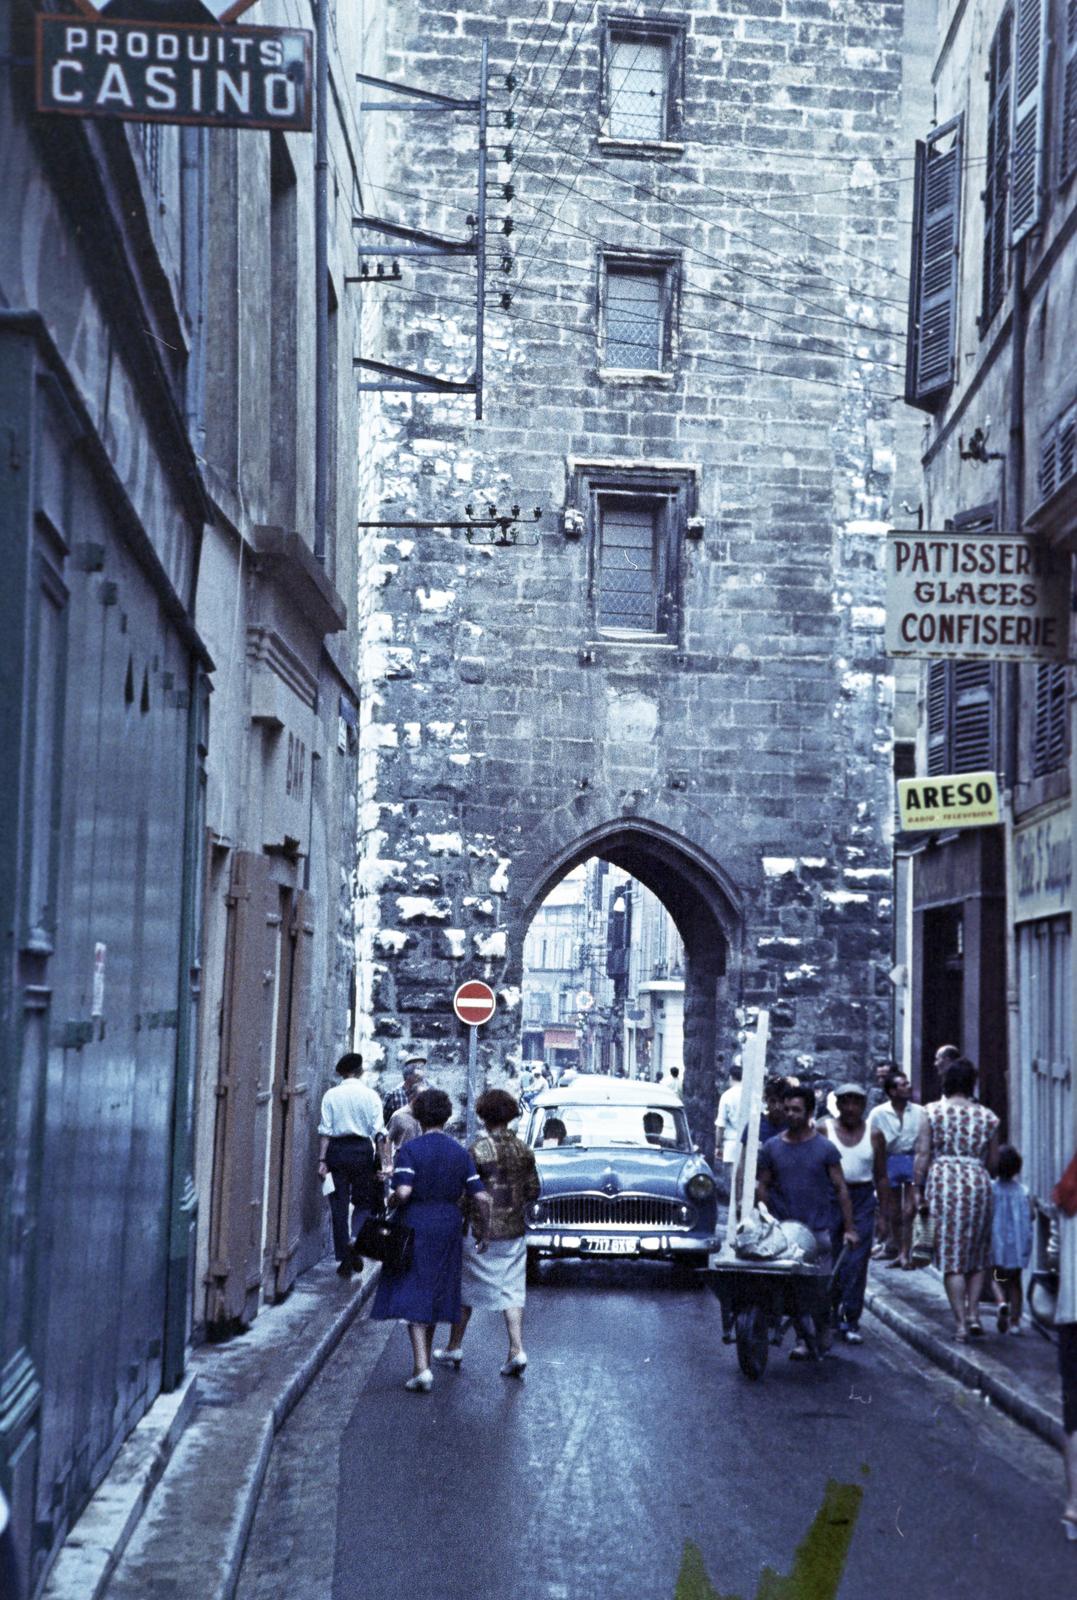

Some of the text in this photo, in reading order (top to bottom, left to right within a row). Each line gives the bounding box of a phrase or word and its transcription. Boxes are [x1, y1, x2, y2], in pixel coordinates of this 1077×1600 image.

[65, 27, 282, 67] PRODUITS
[52, 60, 297, 117] CASINO
[894, 541, 1049, 576] PATISSERI
[914, 581, 1038, 606] GLACES
[901, 612, 1057, 647] CONFISERIE
[286, 731, 305, 804] BAR
[906, 782, 992, 810] ARESO
